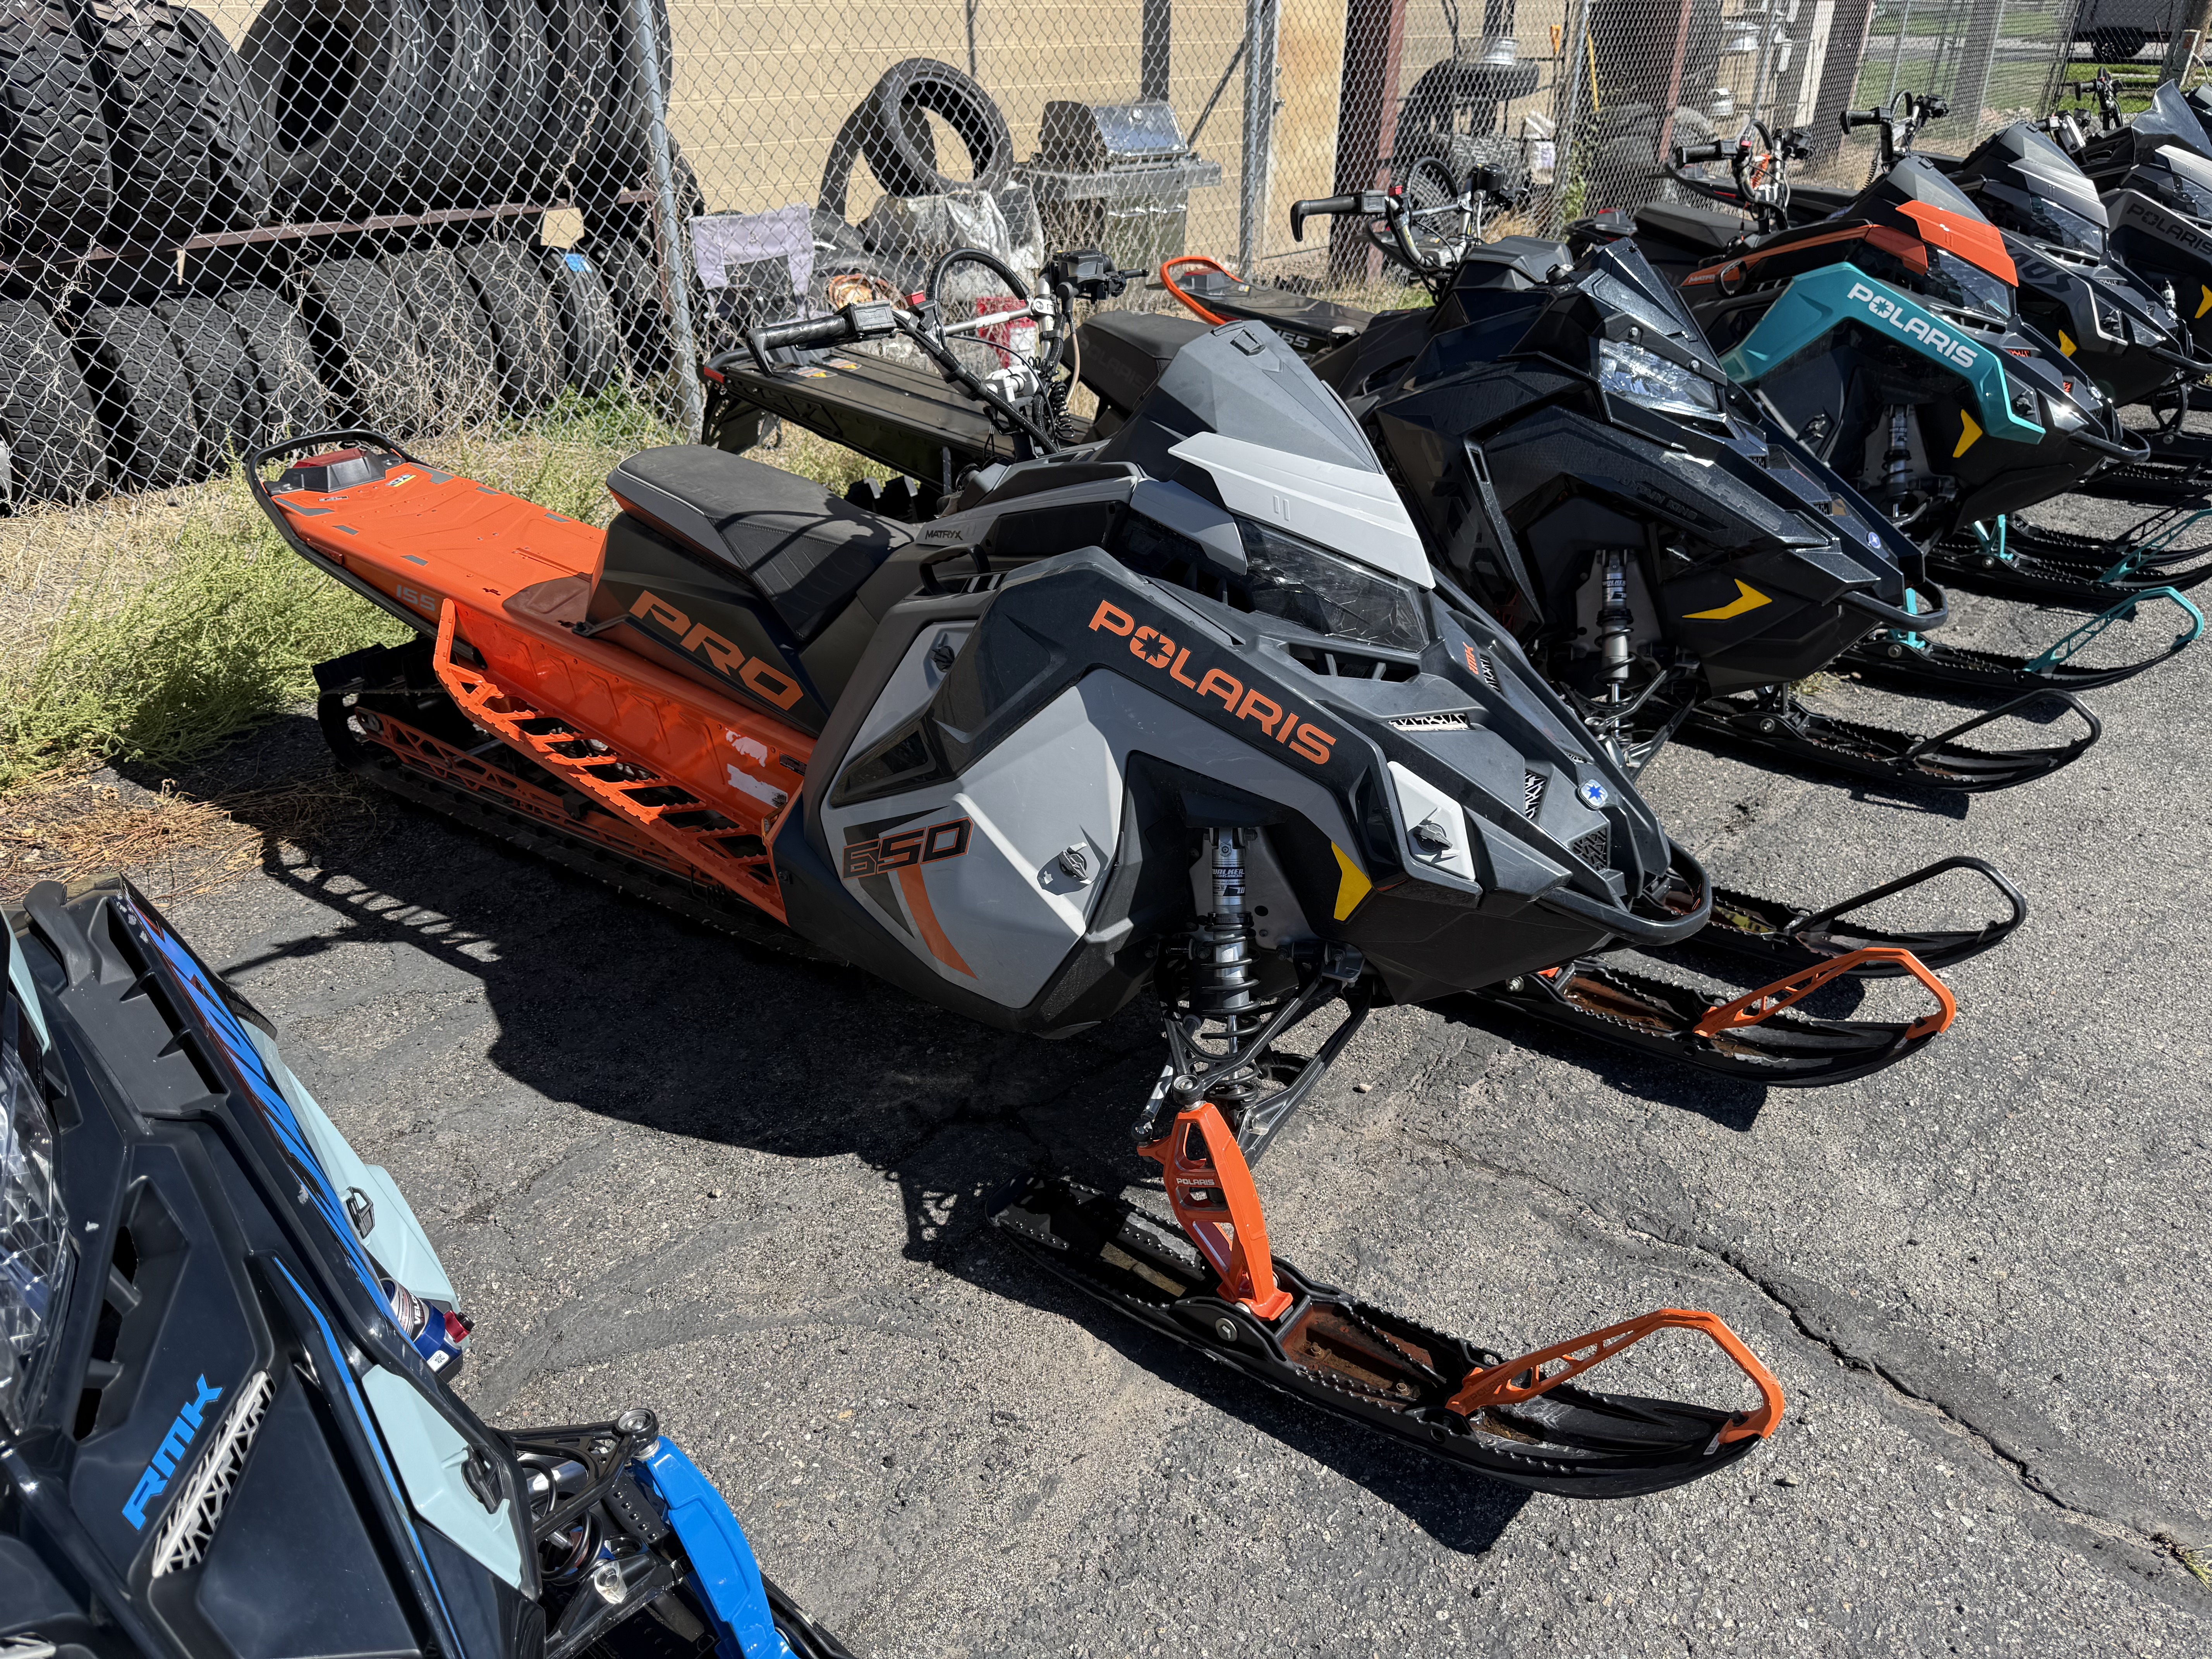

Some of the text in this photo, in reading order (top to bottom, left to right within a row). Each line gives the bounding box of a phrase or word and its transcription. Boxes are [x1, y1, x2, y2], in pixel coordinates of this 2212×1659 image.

[2126, 203, 2212, 256] POLARIS
[1847, 282, 1978, 368] POLARIS
[1659, 451, 1781, 531] POLARIS
[925, 530, 963, 541] MATRYX
[397, 584, 435, 611] 155
[629, 590, 804, 711] PRO
[1088, 599, 1337, 765] POLARIS
[842, 814, 974, 880] 650
[122, 1373, 223, 1530] RMK
